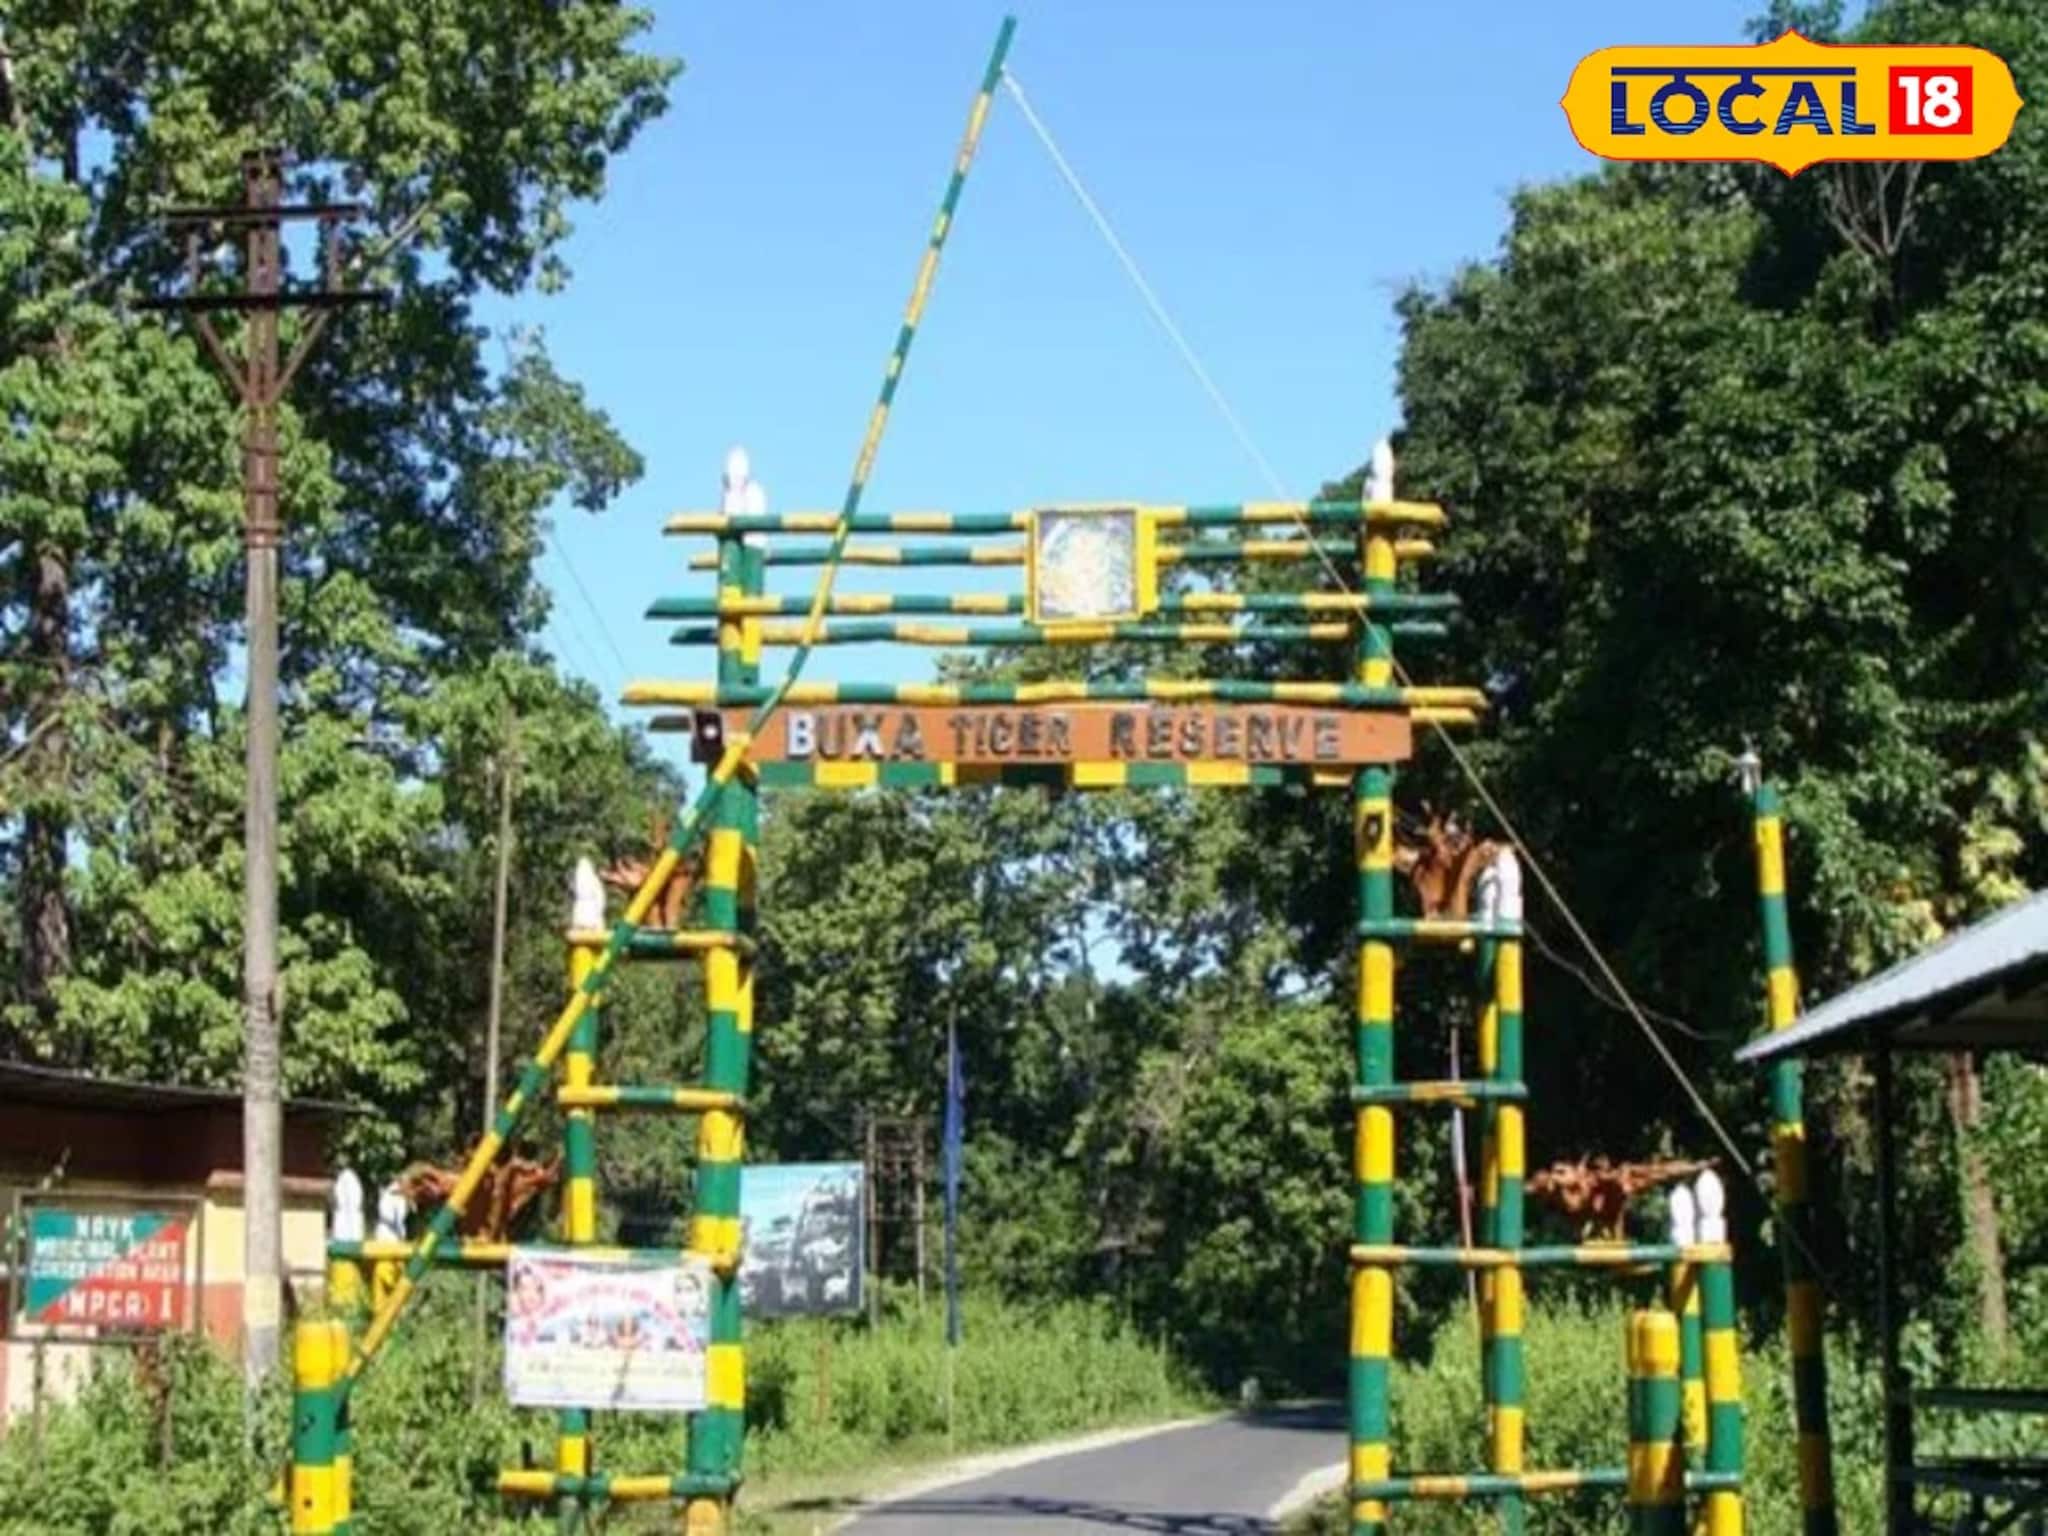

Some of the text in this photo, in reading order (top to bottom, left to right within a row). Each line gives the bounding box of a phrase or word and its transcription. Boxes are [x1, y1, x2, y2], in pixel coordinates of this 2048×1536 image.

[786, 705, 1341, 761] BUXA TIGER RESERVE
